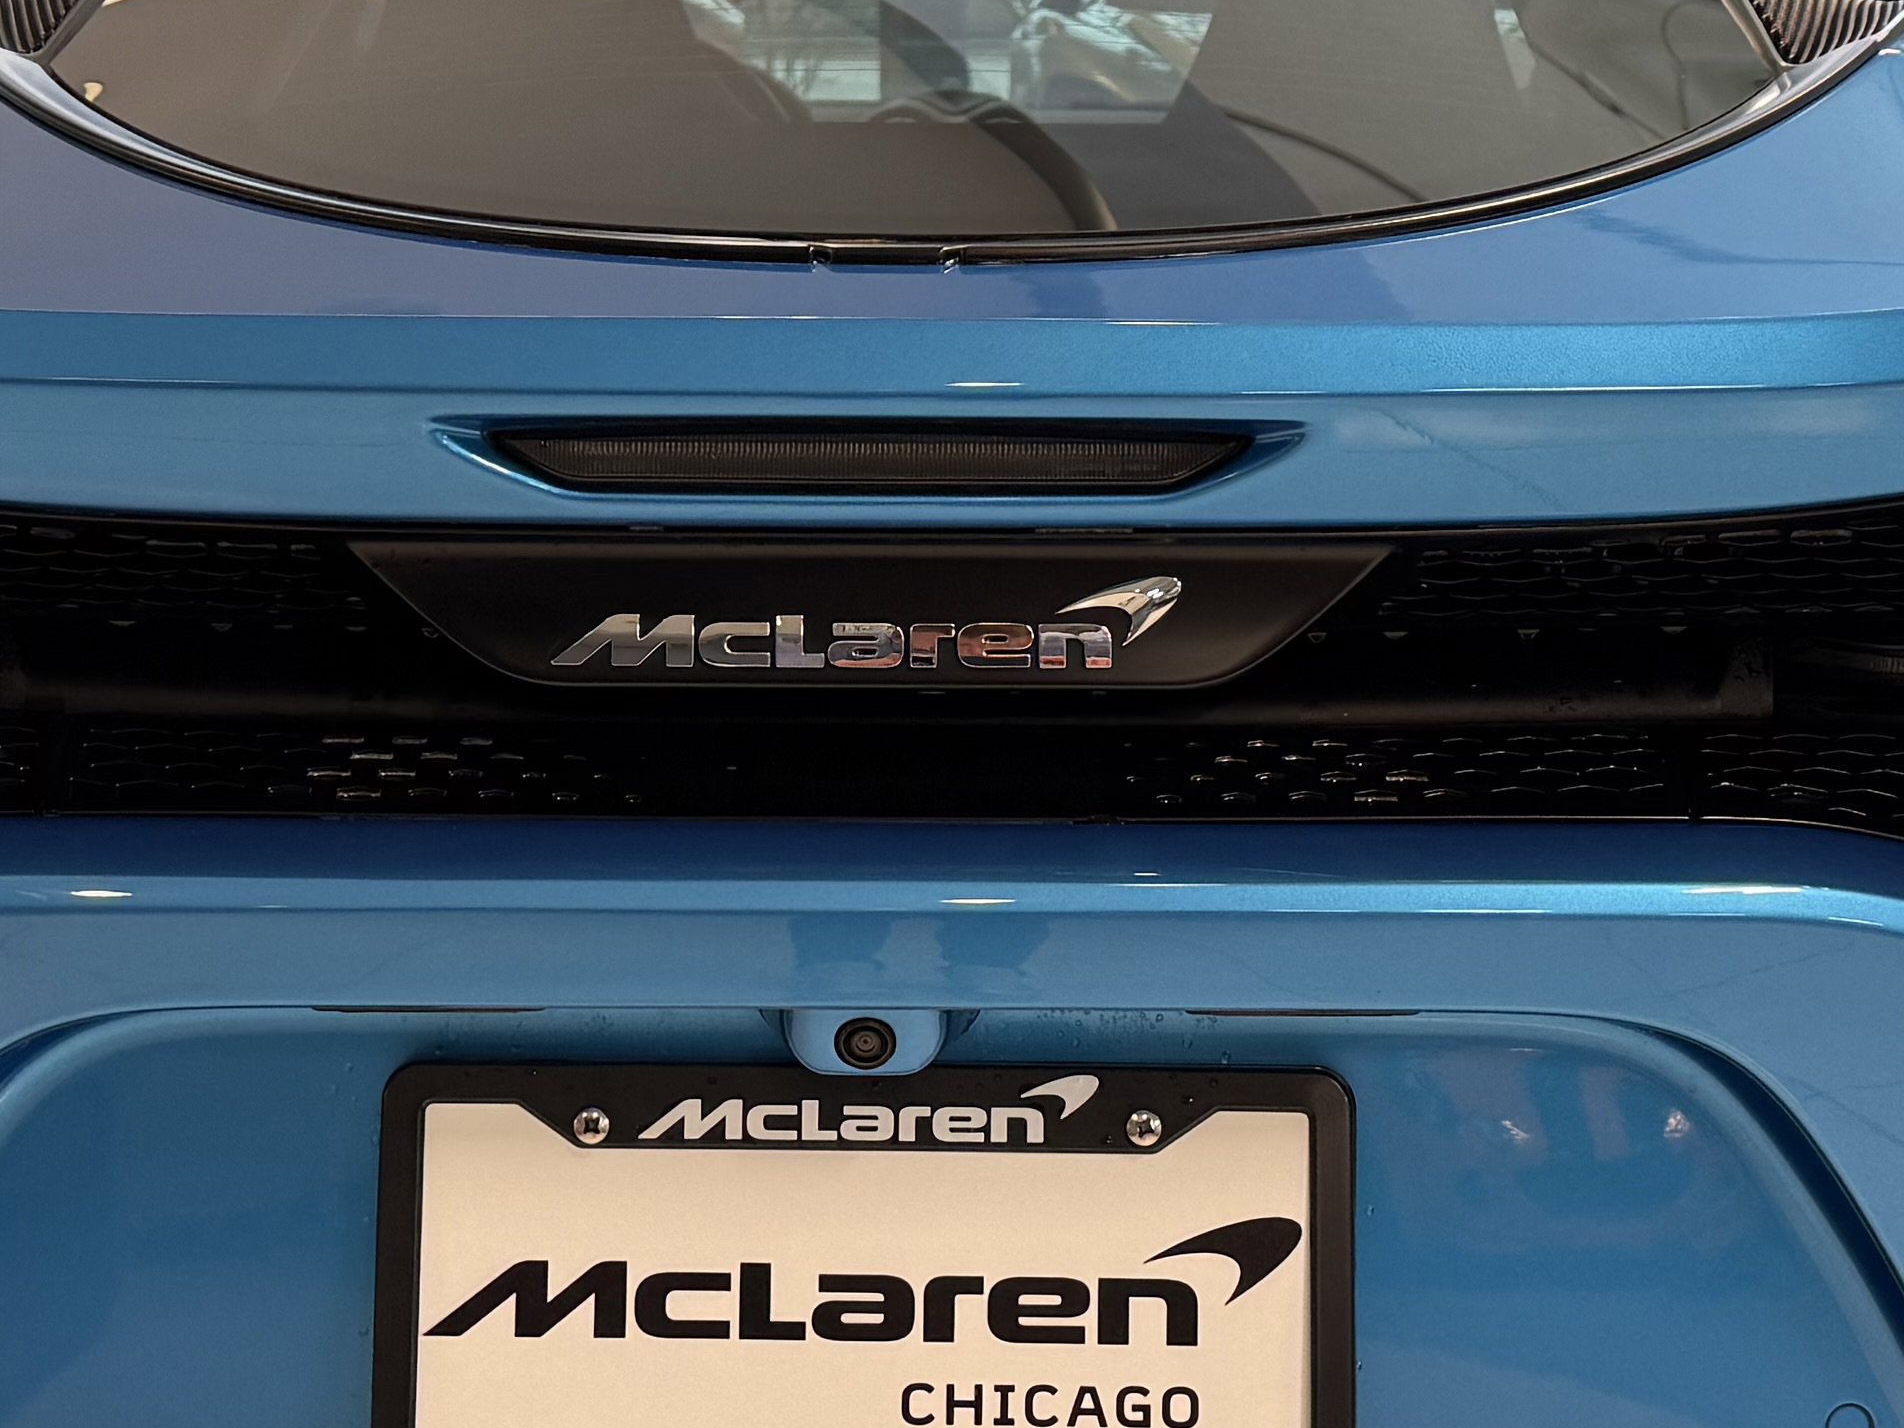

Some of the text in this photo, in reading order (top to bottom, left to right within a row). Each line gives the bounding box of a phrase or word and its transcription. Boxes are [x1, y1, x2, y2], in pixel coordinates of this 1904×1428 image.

[550, 613, 1114, 670] McLaren
[637, 1098, 1046, 1145] McLaren
[422, 1259, 1200, 1347] McLaren
